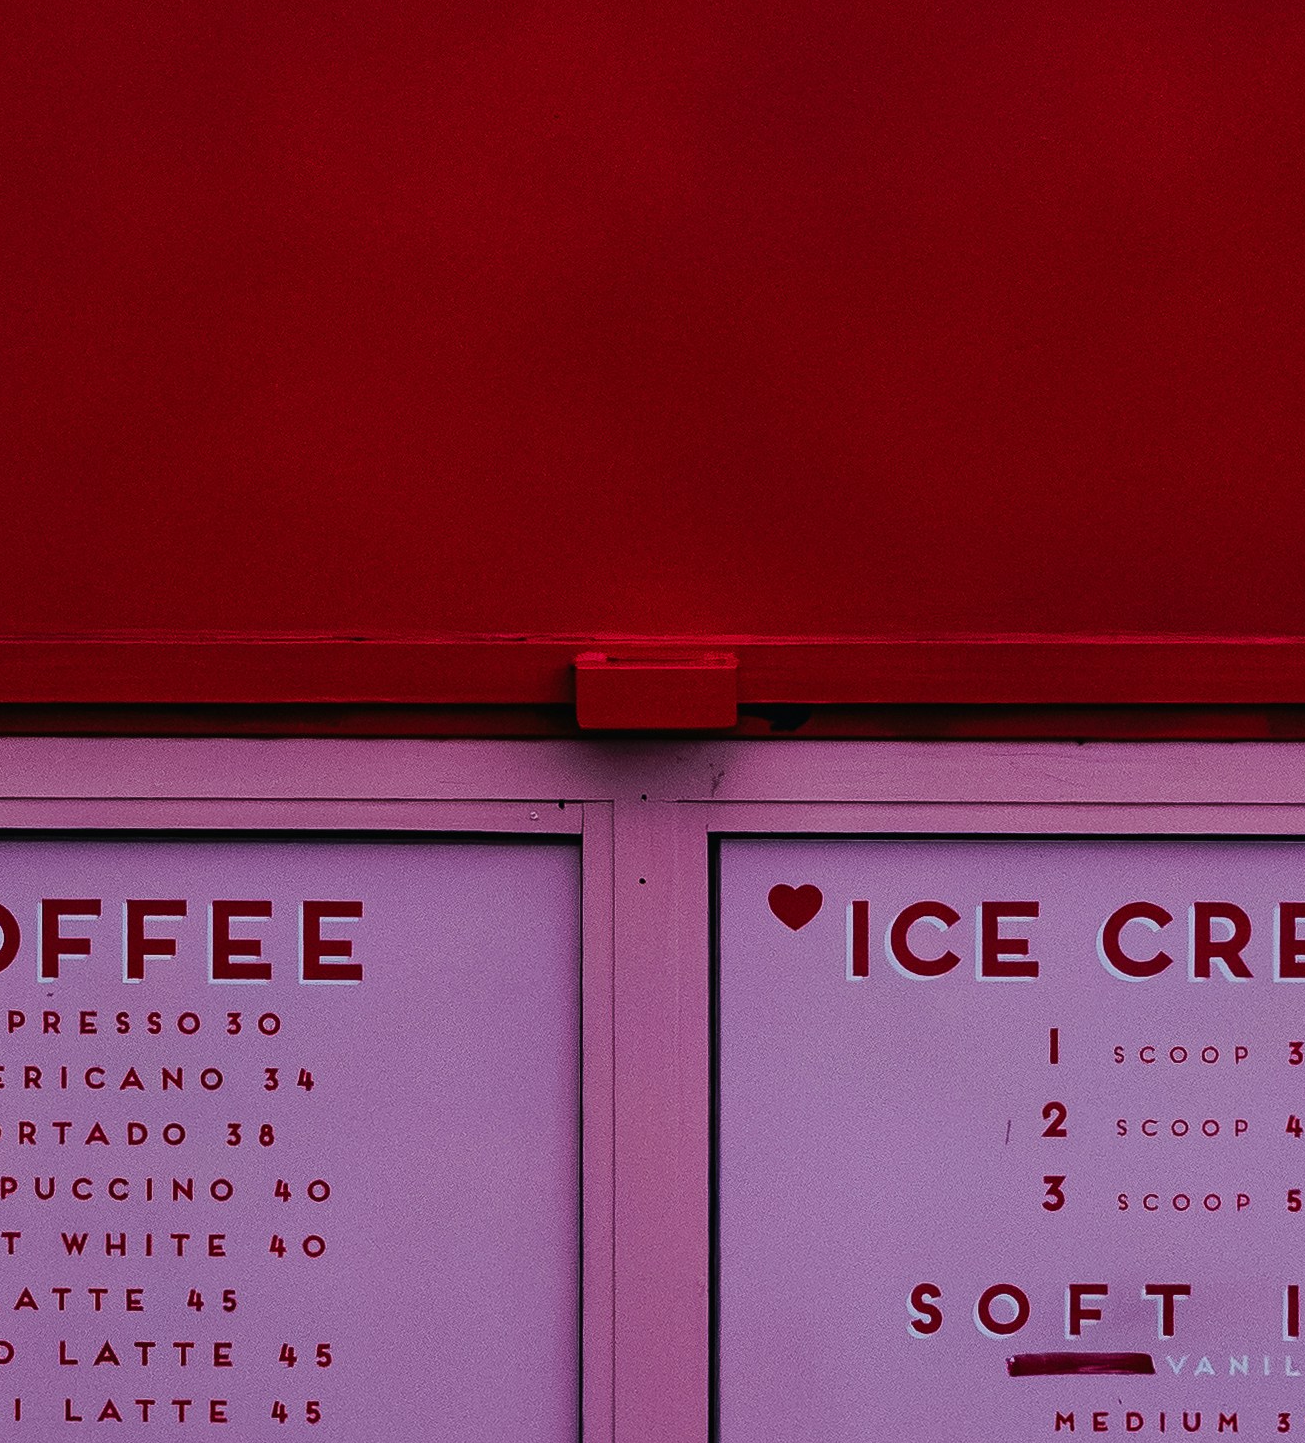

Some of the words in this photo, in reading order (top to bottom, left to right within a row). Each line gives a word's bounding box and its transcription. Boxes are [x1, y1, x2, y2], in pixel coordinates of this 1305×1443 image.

[846, 900, 1040, 983] ICE
[226, 1012, 282, 1036] 30
[1047, 1027, 1059, 1066] 1
[1112, 1044, 1250, 1066] SCOOP
[263, 1067, 315, 1092] 34
[1041, 1101, 1068, 1139] 2
[1115, 1117, 1250, 1138] SCOOP
[226, 1123, 276, 1147] 38
[275, 1178, 332, 1203] 40
[1041, 1175, 1066, 1213] 3
[1117, 1192, 1251, 1213] SCOOP
[61, 1232, 228, 1257] WHITE
[268, 1234, 326, 1259] 40
[186, 1289, 237, 1314] 45
[907, 1282, 1191, 1342] SOFT
[58, 1340, 234, 1368] LATTE
[278, 1343, 333, 1368] 45
[64, 1398, 229, 1424] LATTE
[270, 1401, 322, 1425] 45
[1054, 1410, 1242, 1434] MEDIUM
